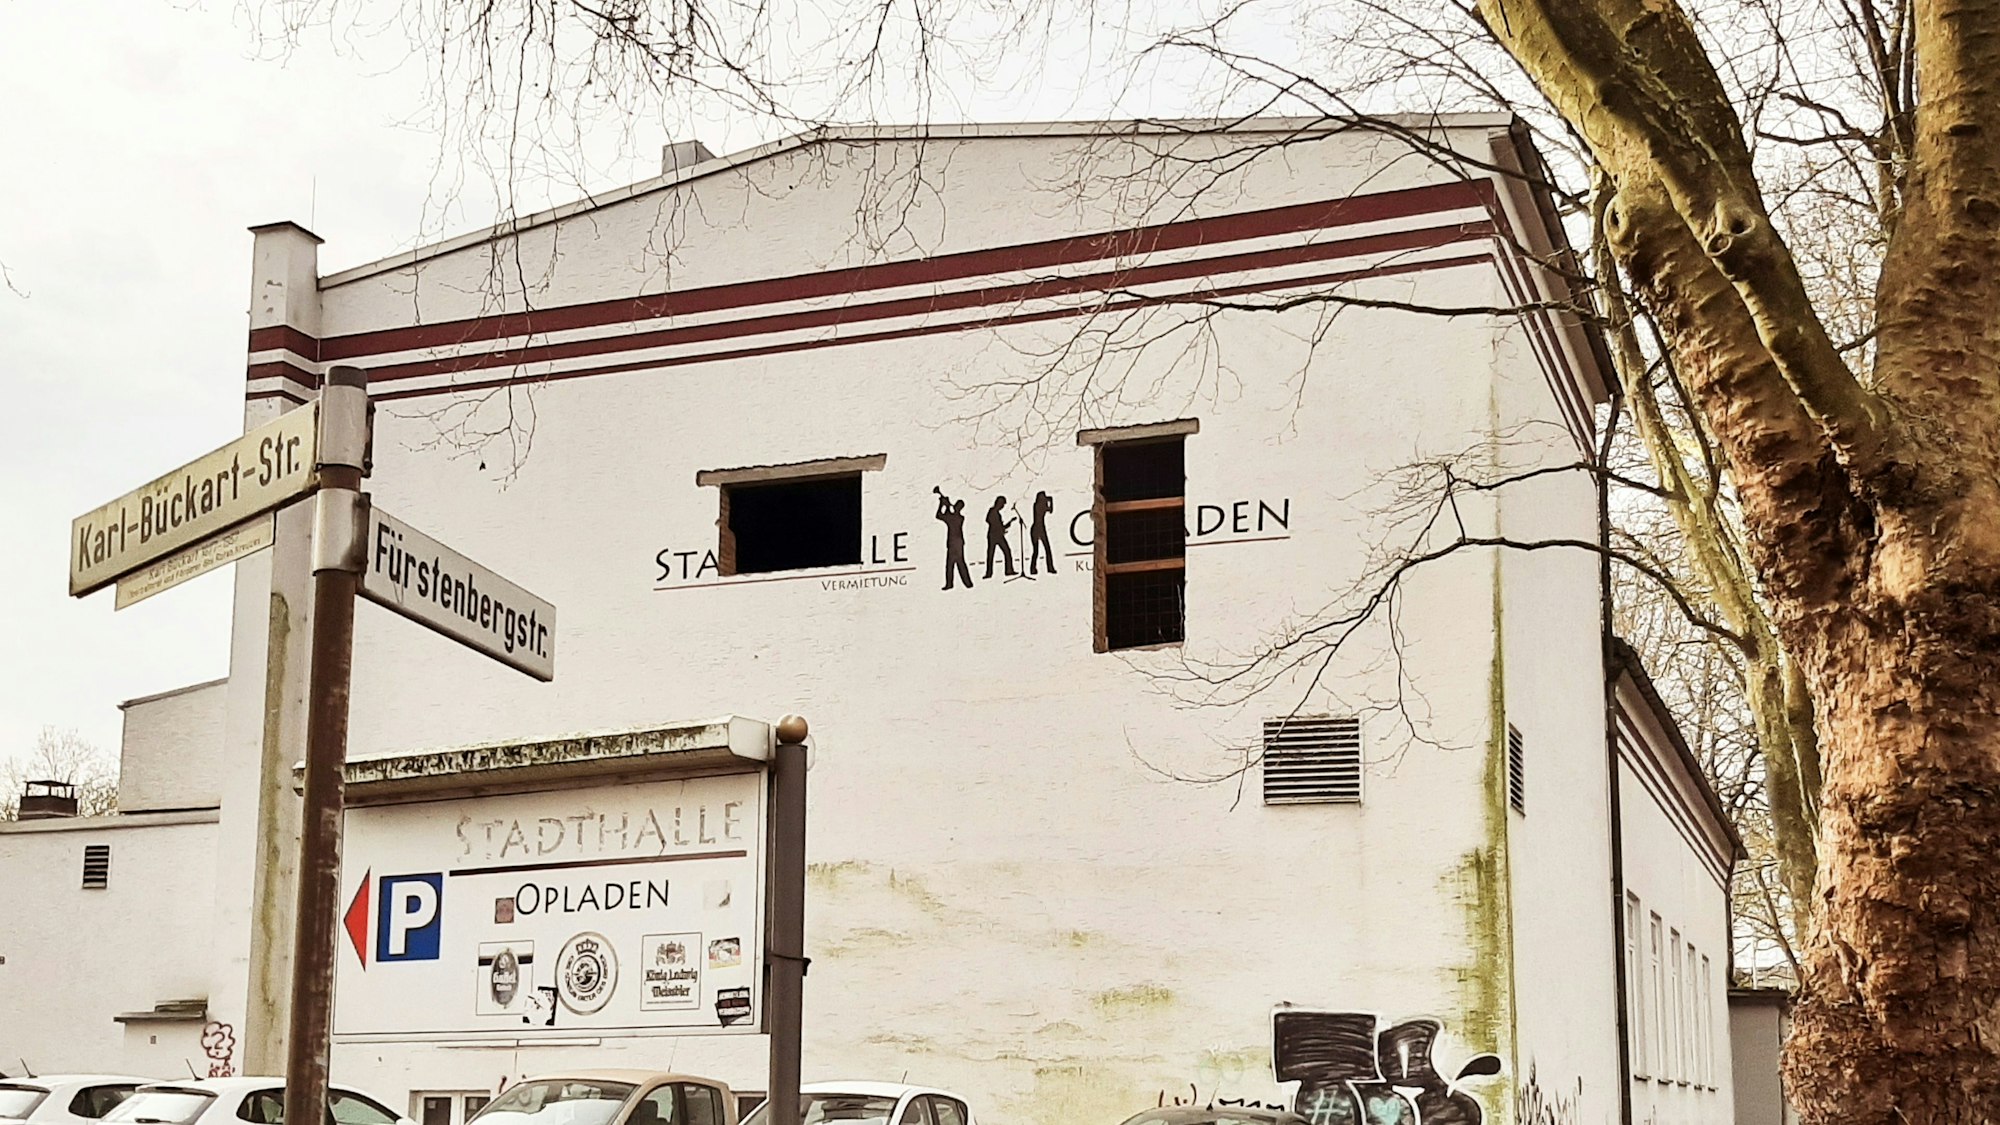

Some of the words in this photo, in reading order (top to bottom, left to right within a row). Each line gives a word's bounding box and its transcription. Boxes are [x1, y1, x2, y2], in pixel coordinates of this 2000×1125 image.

[78, 430, 301, 573] Karl-Bückart-Str.
[375, 521, 548, 659] Fürstenbergstr.
[821, 575, 908, 592] VERMIETUNG
[456, 801, 743, 863] STADTHALLE
[388, 880, 438, 956] P
[515, 879, 670, 916] OPLADEN
